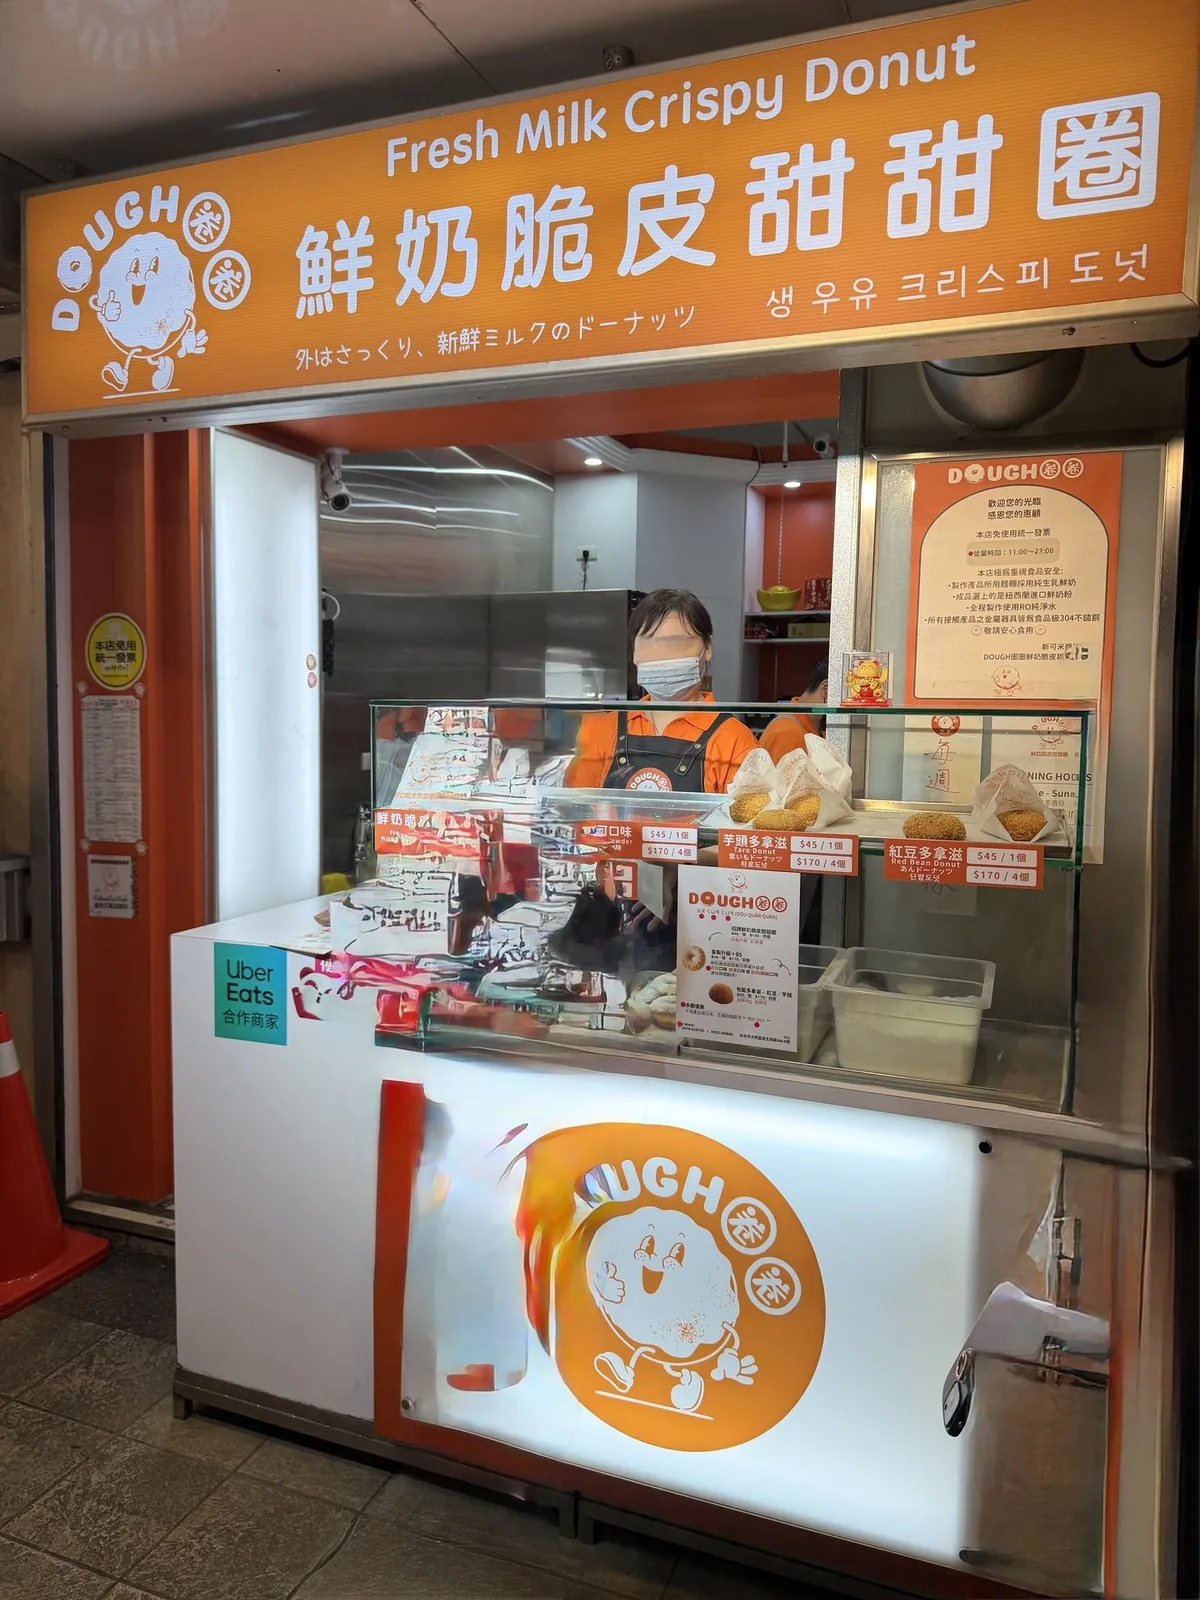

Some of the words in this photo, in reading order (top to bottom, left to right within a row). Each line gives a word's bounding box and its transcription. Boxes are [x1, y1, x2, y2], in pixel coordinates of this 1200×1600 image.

[387, 119, 499, 177] Fresh
[516, 98, 608, 154] Milk
[624, 74, 784, 132] Crispy
[806, 34, 977, 102] Donut
[295, 92, 1161, 320] 鮮奶脆皮甜甜圈
[766, 286, 794, 318] 생
[812, 277, 877, 314] 우유
[896, 256, 1050, 302] 크리스피
[1070, 243, 1149, 284] 도넛
[295, 305, 696, 371] 外はさっくり、新鮮ミルクのドーナッツ
[988, 497, 1042, 508] 歡迎您的光臨
[987, 509, 1041, 520] 感恩您的惠顧
[976, 528, 1051, 539] 本店免使用統一發票
[984, 626, 1034, 635] 敬請安心食用
[95, 640, 136, 651] 本店免用
[95, 652, 137, 663] 統一發票
[650, 830, 666, 839] $45
[675, 831, 689, 840] 1個
[723, 834, 788, 850] 芋頭多拿滋
[799, 839, 817, 849] $45
[828, 841, 843, 851] 1個
[647, 846, 669, 856] $170
[677, 848, 692, 857] 4個
[889, 844, 963, 862] 紅豆多拿滋
[977, 851, 997, 861] $45
[1009, 853, 1027, 863] 1個
[796, 857, 820, 867] $170
[830, 859, 846, 869] 4個
[933, 860, 961, 868] Donut
[973, 870, 1001, 880] $170
[1011, 872, 1030, 882] 4個
[226, 959, 274, 982] Uber
[226, 983, 274, 1006] Eats
[222, 1009, 279, 1030] 合作商家
